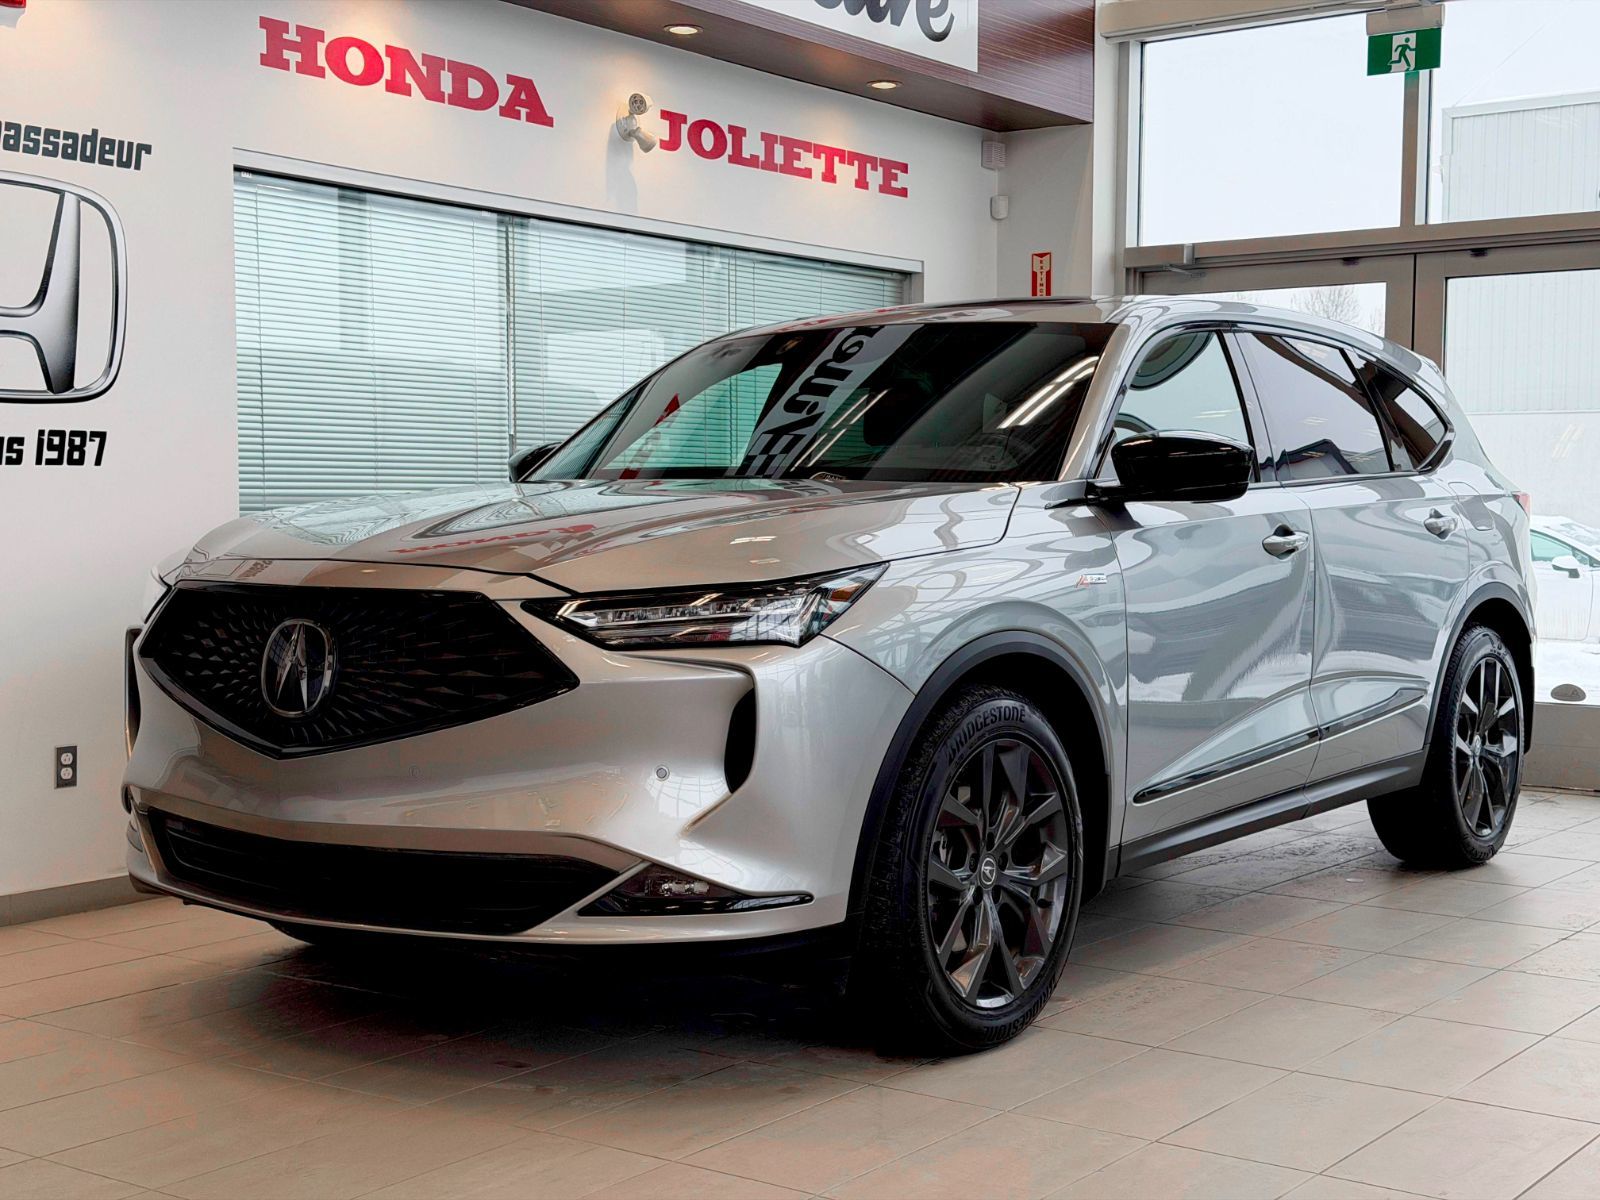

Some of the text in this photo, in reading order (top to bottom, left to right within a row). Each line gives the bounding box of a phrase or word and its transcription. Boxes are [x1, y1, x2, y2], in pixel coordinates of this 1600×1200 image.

[259, 15, 554, 128] HONDA
[0, 120, 153, 171] assadeur
[659, 109, 908, 198] JOLIETTE
[35, 429, 107, 467] 1987
[946, 704, 1027, 766] BRIDGESTONE
